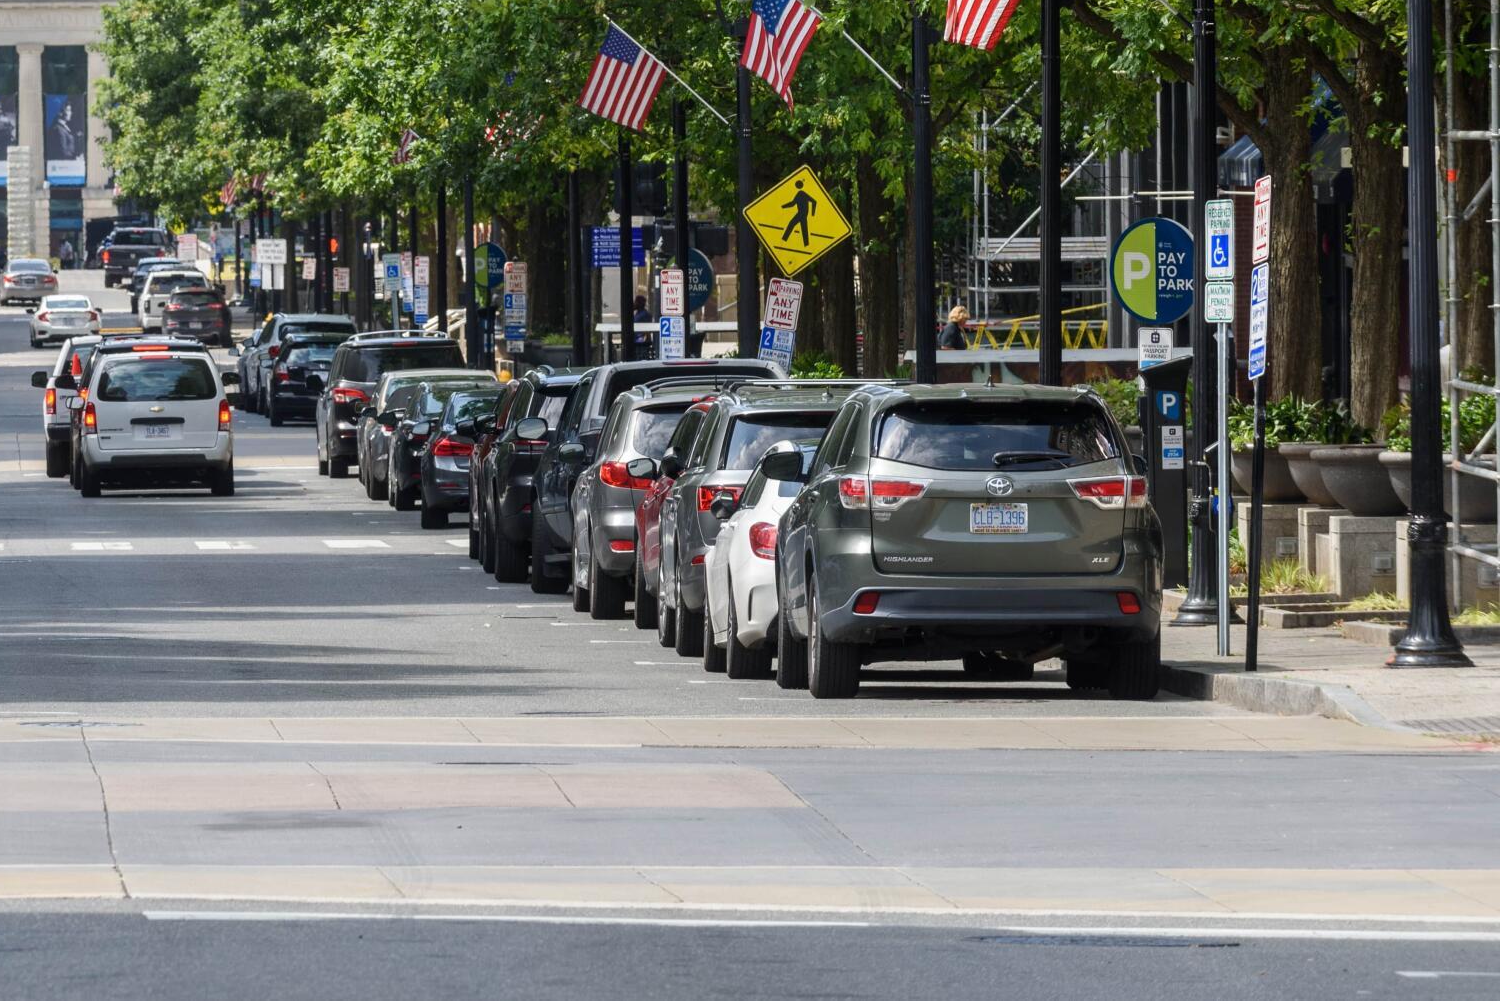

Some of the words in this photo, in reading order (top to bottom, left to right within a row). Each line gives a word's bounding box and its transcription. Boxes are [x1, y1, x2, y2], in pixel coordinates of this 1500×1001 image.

[34, 13, 101, 27] AUDITO
[1257, 205, 1267, 221] ANY
[1256, 222, 1267, 240] TIME
[1158, 252, 1186, 264] PAY
[475, 258, 485, 273] P
[688, 268, 703, 276] PAY
[1123, 251, 1151, 290] P
[1158, 265, 1177, 278] TO
[688, 276, 699, 284] TO
[1158, 278, 1194, 291] PARK
[666, 287, 679, 296] ANY
[688, 284, 708, 292] PARK
[780, 285, 800, 295] PARKING
[1252, 274, 1258, 301] 2
[506, 296, 512, 307] 2
[666, 298, 679, 306] TIME
[773, 298, 794, 308] ANY
[771, 308, 793, 320] TIME
[662, 320, 670, 335] 2
[764, 331, 771, 345] 2
[1162, 393, 1177, 415] P
